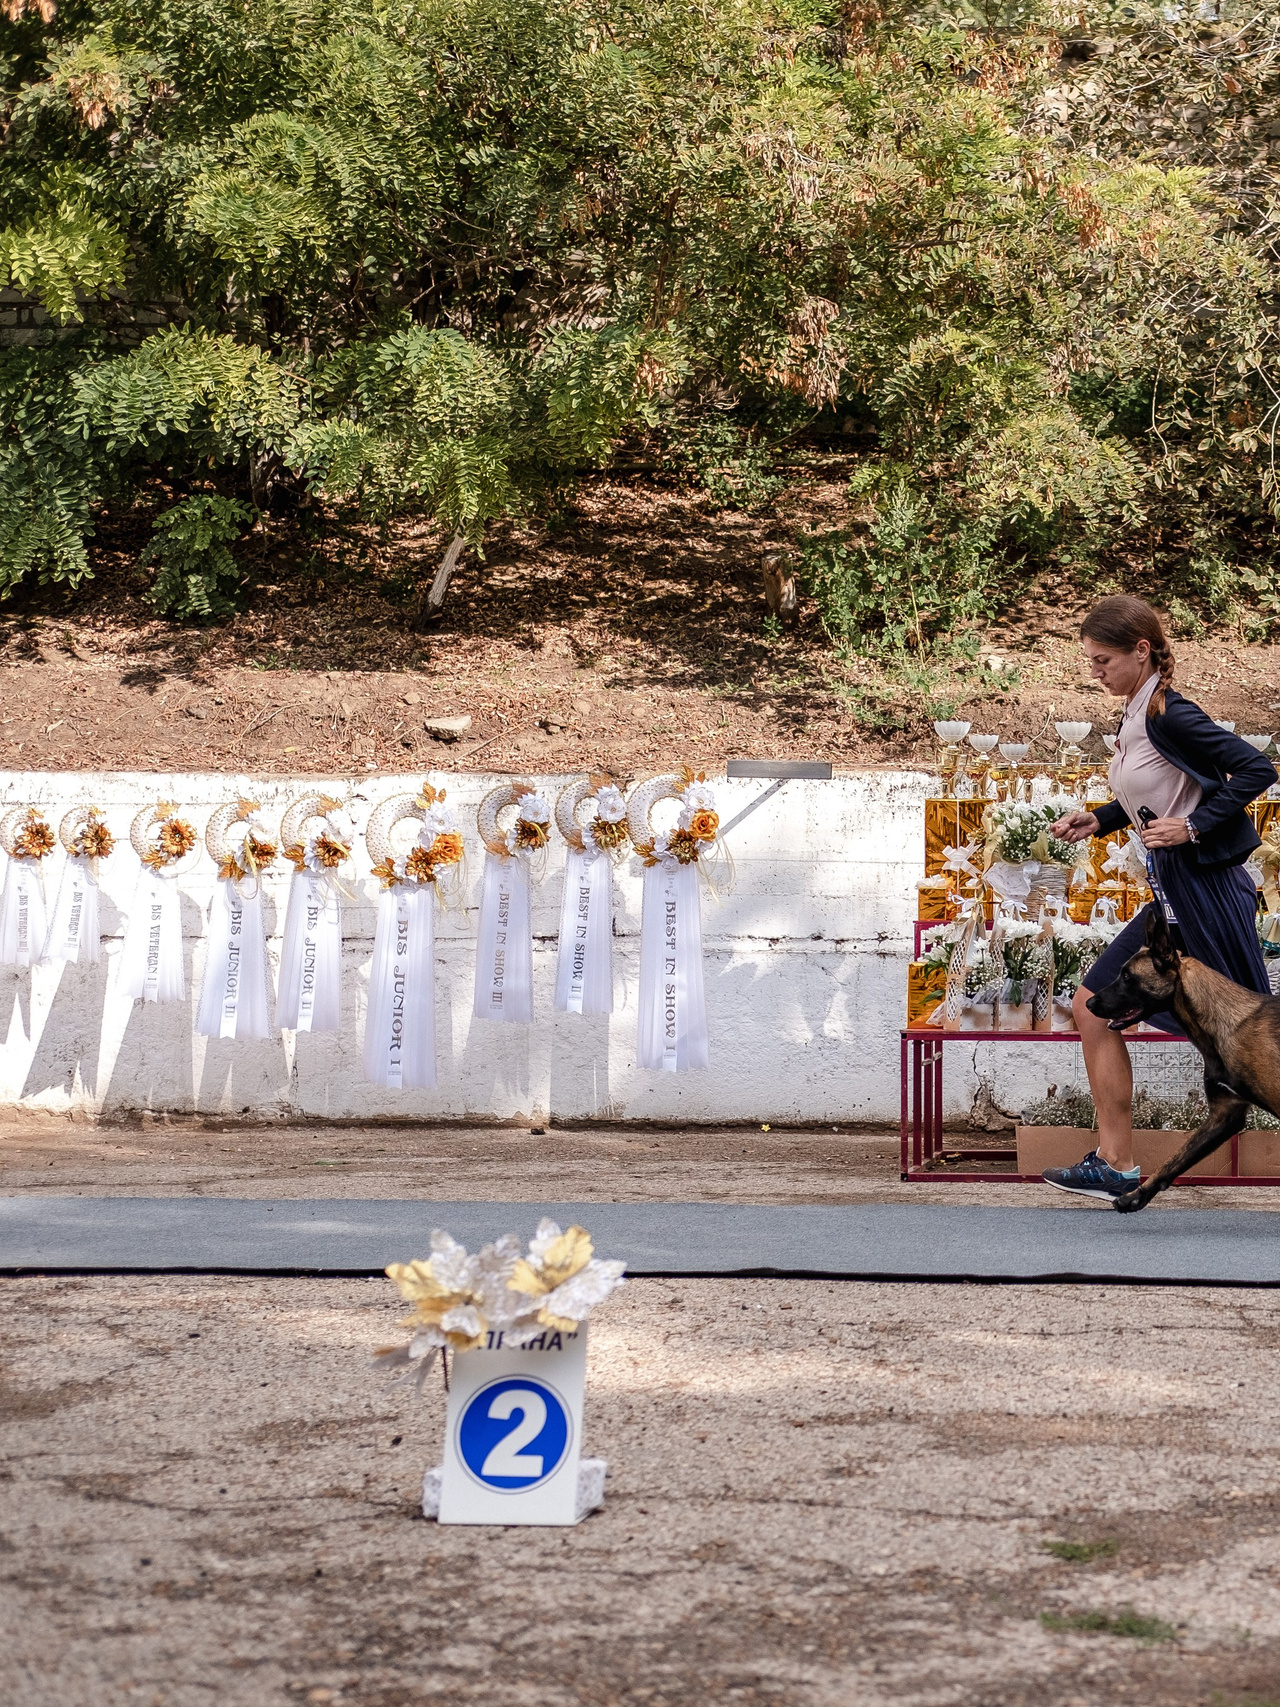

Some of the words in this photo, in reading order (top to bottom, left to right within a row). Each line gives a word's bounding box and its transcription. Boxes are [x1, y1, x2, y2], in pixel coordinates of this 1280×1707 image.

[150, 904, 162, 921] BIS
[230, 910, 243, 935] BIS
[307, 906, 318, 931] BIS
[498, 893, 510, 928] BEST
[578, 886, 591, 922] BEST
[397, 920, 409, 956] BIS
[496, 931, 507, 945] IN
[576, 926, 588, 940] IN
[665, 900, 676, 951] BEST
[147, 924, 161, 974] VETERAN
[301, 937, 316, 996] JUNIOR
[572, 943, 586, 982] SHOW
[665, 957, 676, 976] IN
[225, 942, 240, 1000] JUNIOR
[493, 949, 506, 988] SHOW
[389, 965, 406, 1052] JUNIOR
[664, 984, 676, 1039] SHOW
[480, 1389, 548, 1478] 2
